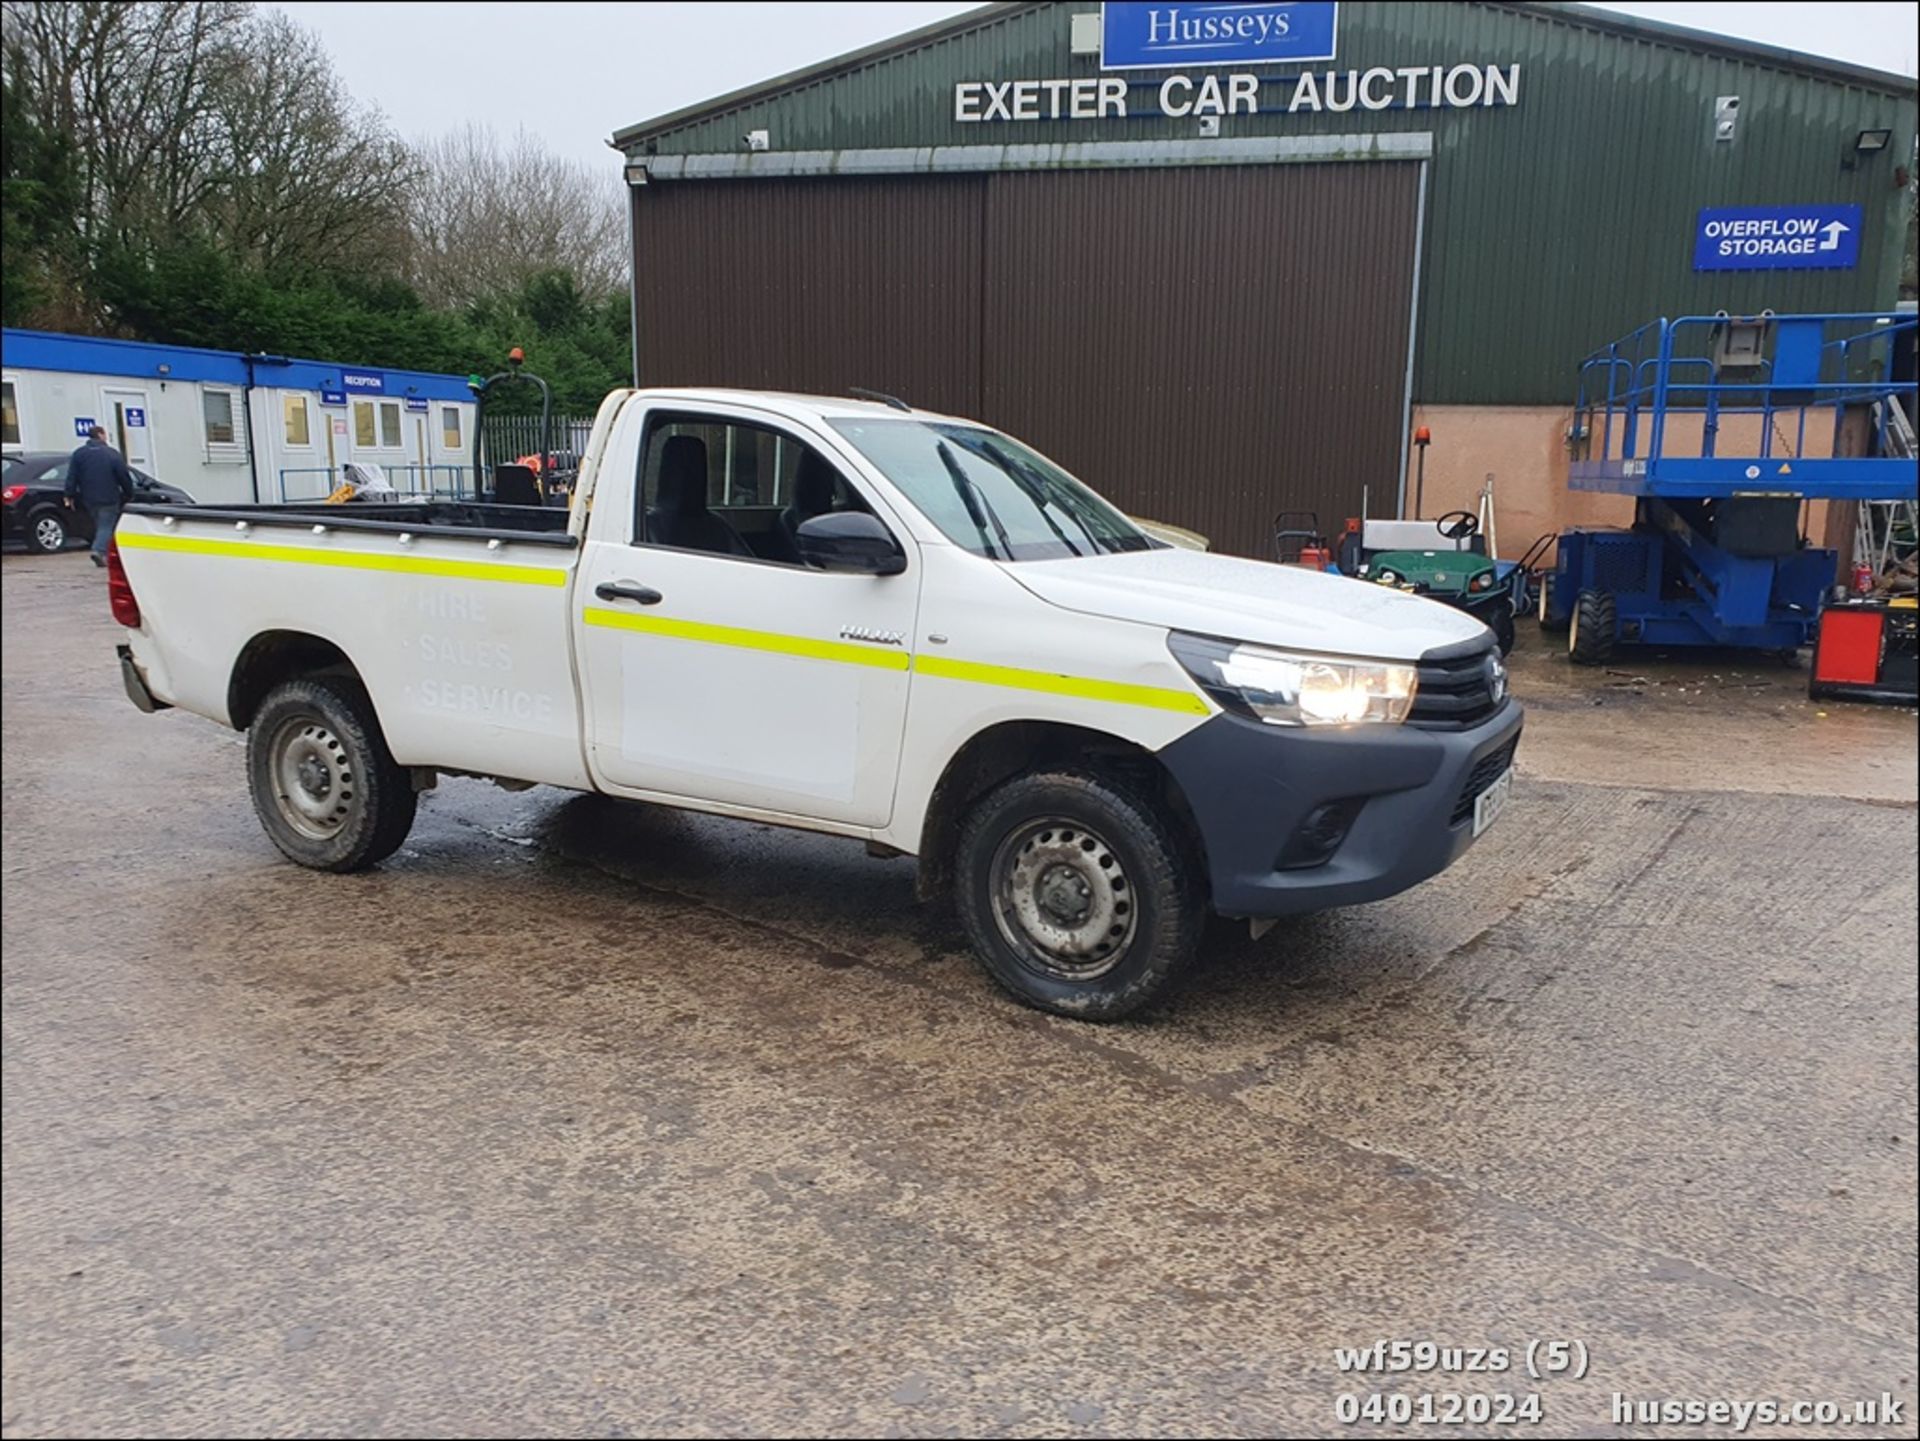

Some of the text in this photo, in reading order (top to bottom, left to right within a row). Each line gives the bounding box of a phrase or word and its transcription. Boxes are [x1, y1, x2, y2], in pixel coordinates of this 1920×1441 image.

[1148, 9, 1289, 45] Husseys
[955, 64, 1521, 122] EXETER CAR AUCTION
[1705, 219, 1819, 237] OVERFLOW
[1719, 238, 1815, 256] STORAGE
[344, 375, 382, 388] RECEPTION
[418, 590, 487, 622] HIRE
[840, 624, 905, 645] HILUX
[419, 633, 513, 671] SALES
[420, 679, 553, 720] SERVICE
